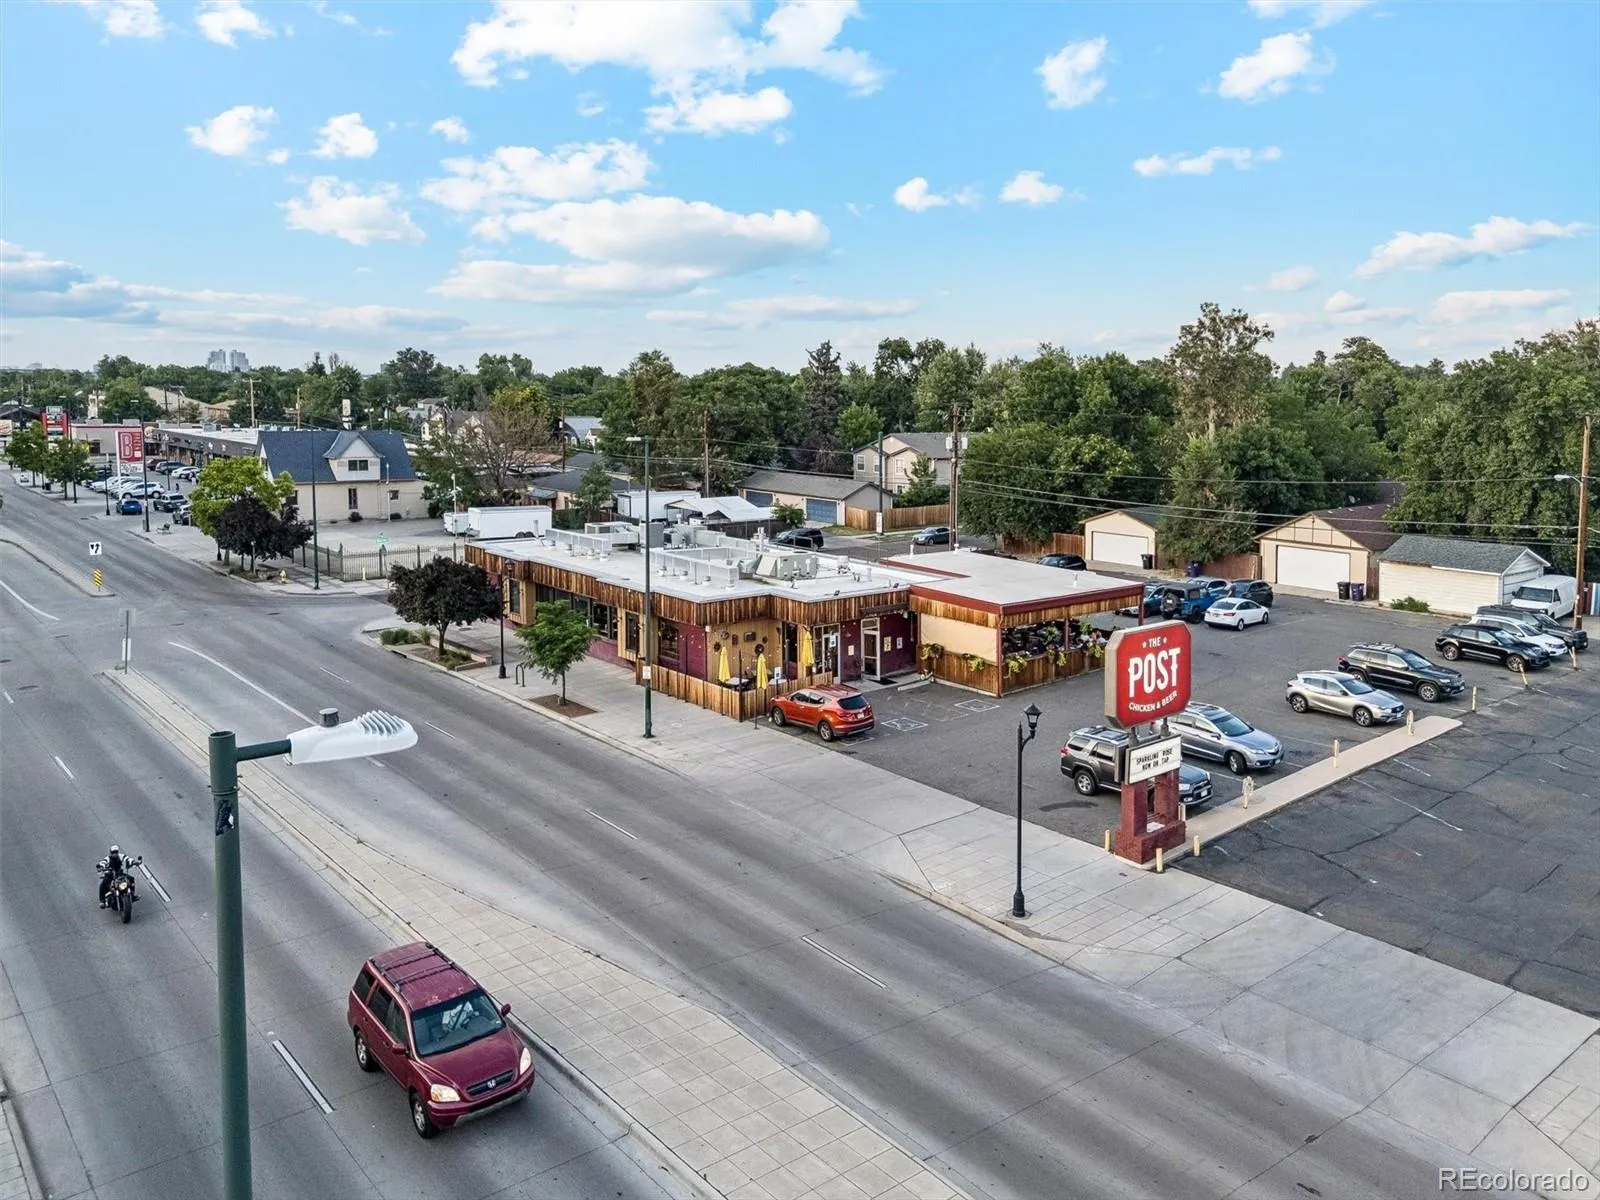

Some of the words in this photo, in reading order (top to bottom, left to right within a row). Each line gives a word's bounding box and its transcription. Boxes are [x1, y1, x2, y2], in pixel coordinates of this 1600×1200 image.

[120, 432, 133, 459] B
[1149, 637, 1161, 648] THE
[1128, 647, 1181, 698] POST
[1129, 702, 1155, 712] CHICKEN
[1162, 691, 1177, 706] BEER
